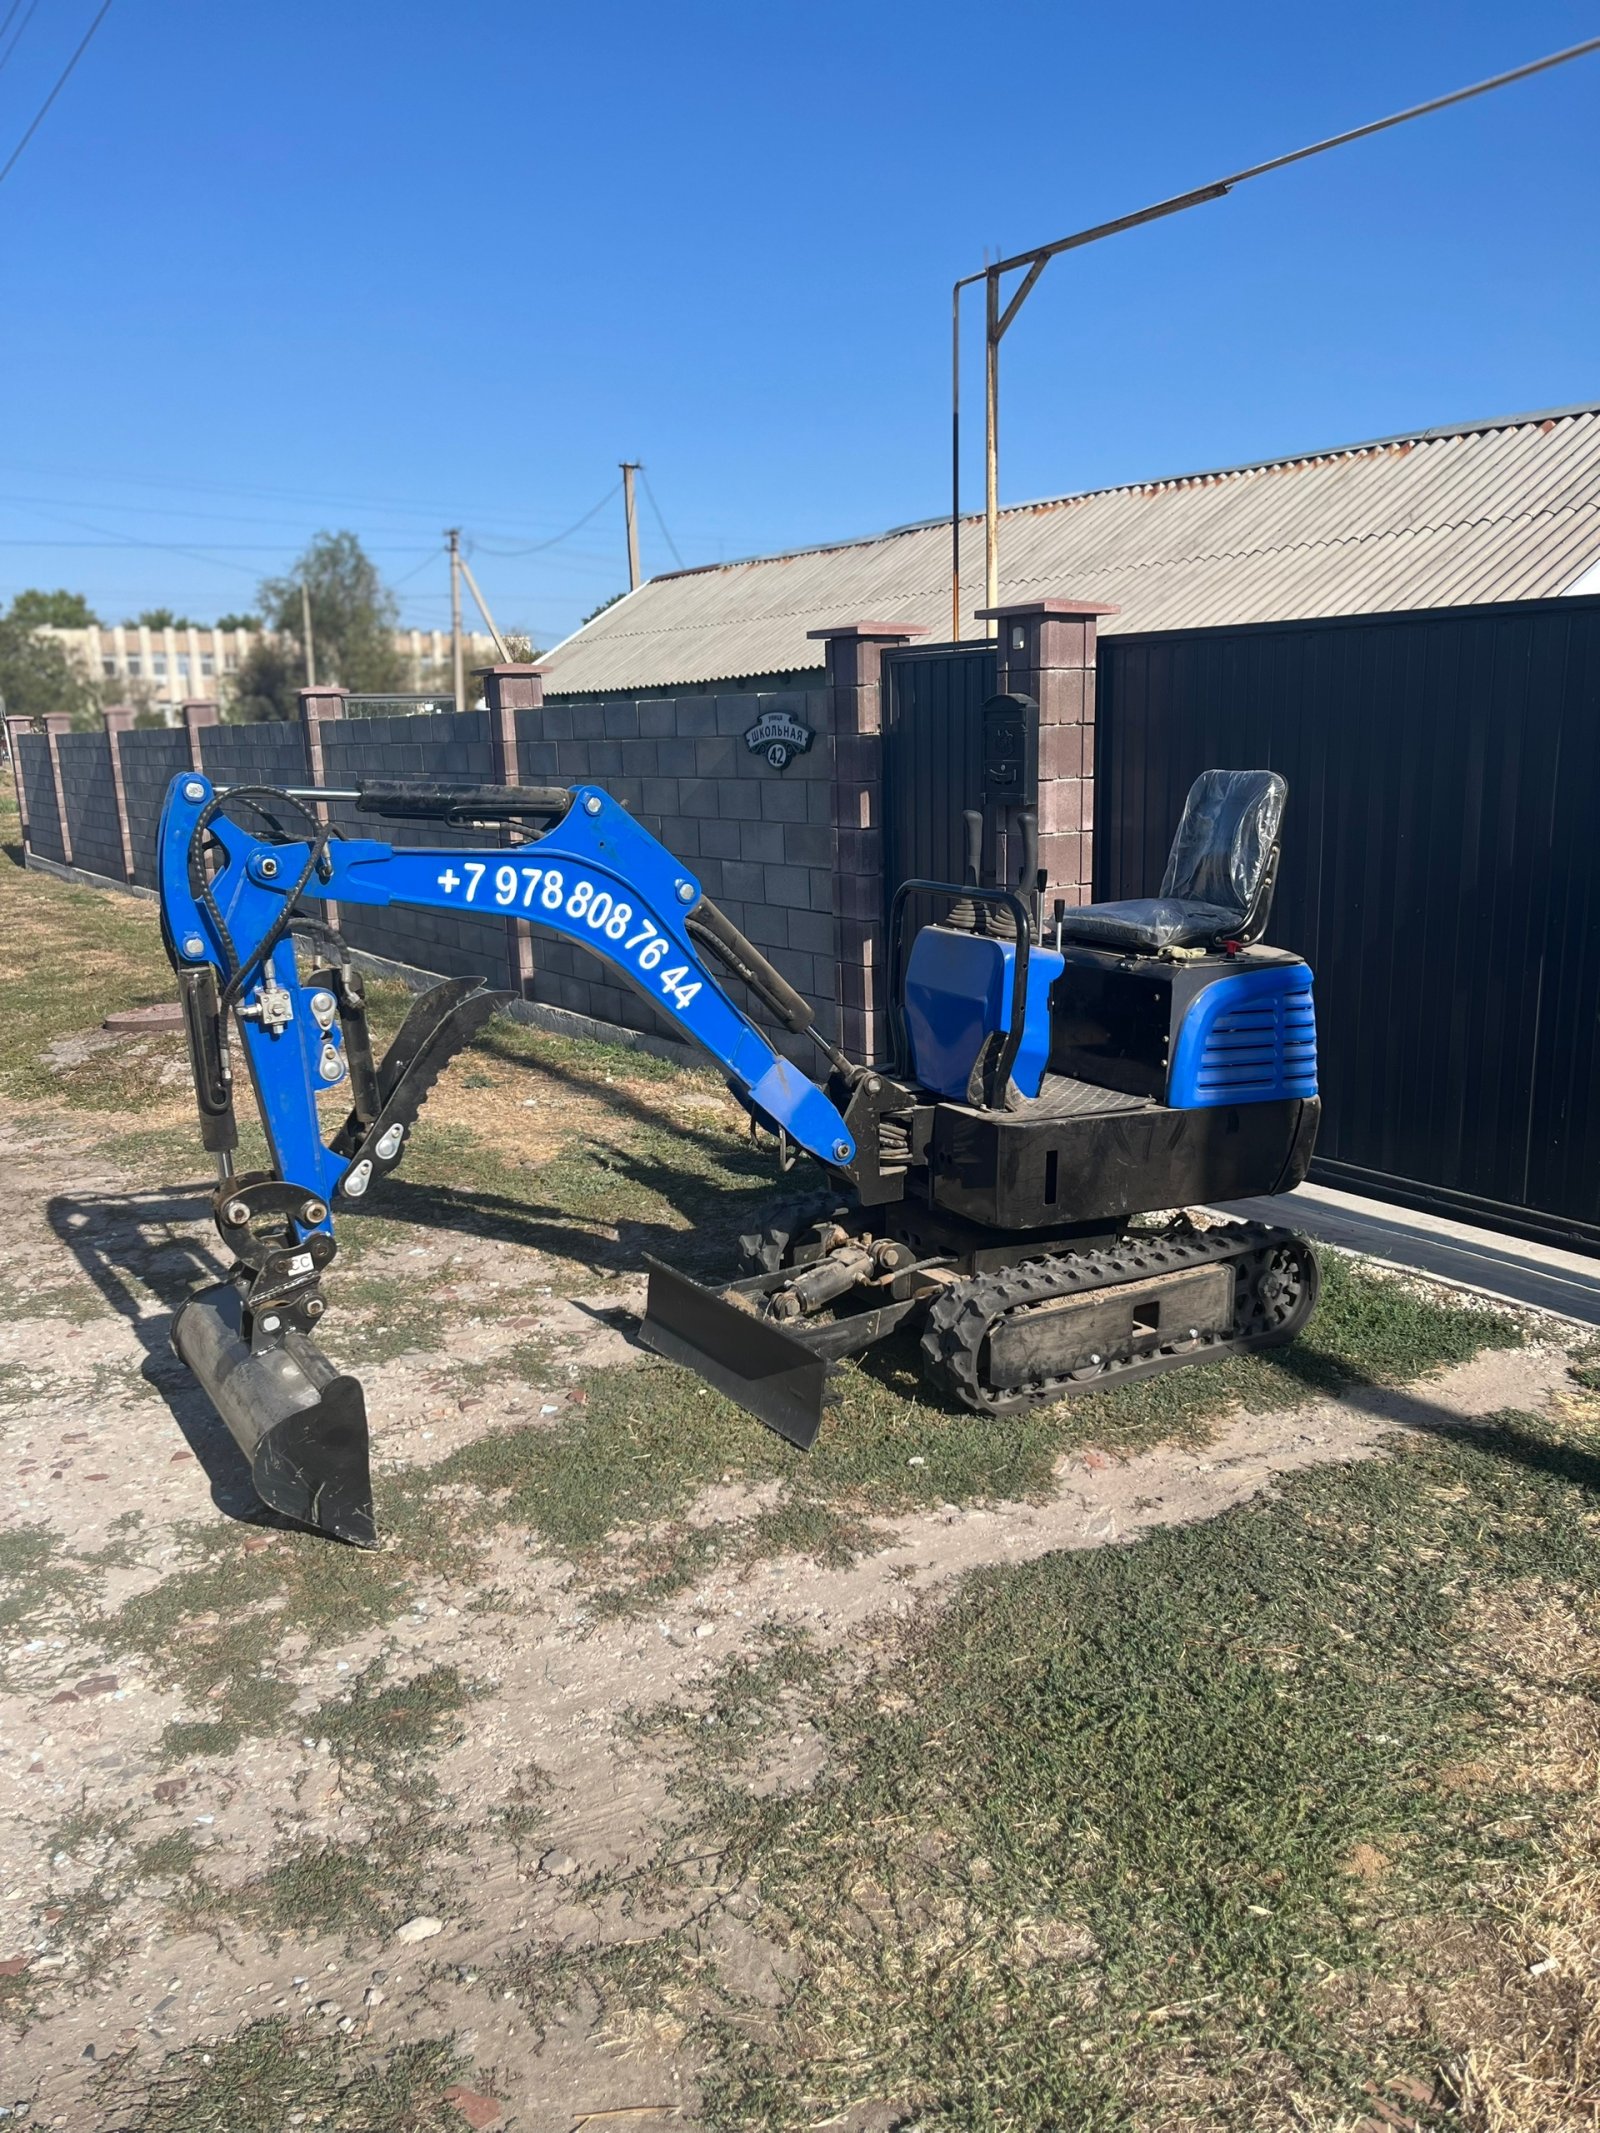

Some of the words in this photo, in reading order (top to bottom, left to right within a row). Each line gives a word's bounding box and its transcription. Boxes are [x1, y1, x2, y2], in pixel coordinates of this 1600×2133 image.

[752, 725, 803, 742] ШКОЛЬНАЯ
[770, 747, 783, 764] 42
[437, 863, 486, 902] +7
[495, 865, 564, 909] 978
[565, 881, 633, 940] 808
[624, 918, 669, 970] 76
[660, 965, 702, 1010] 44
